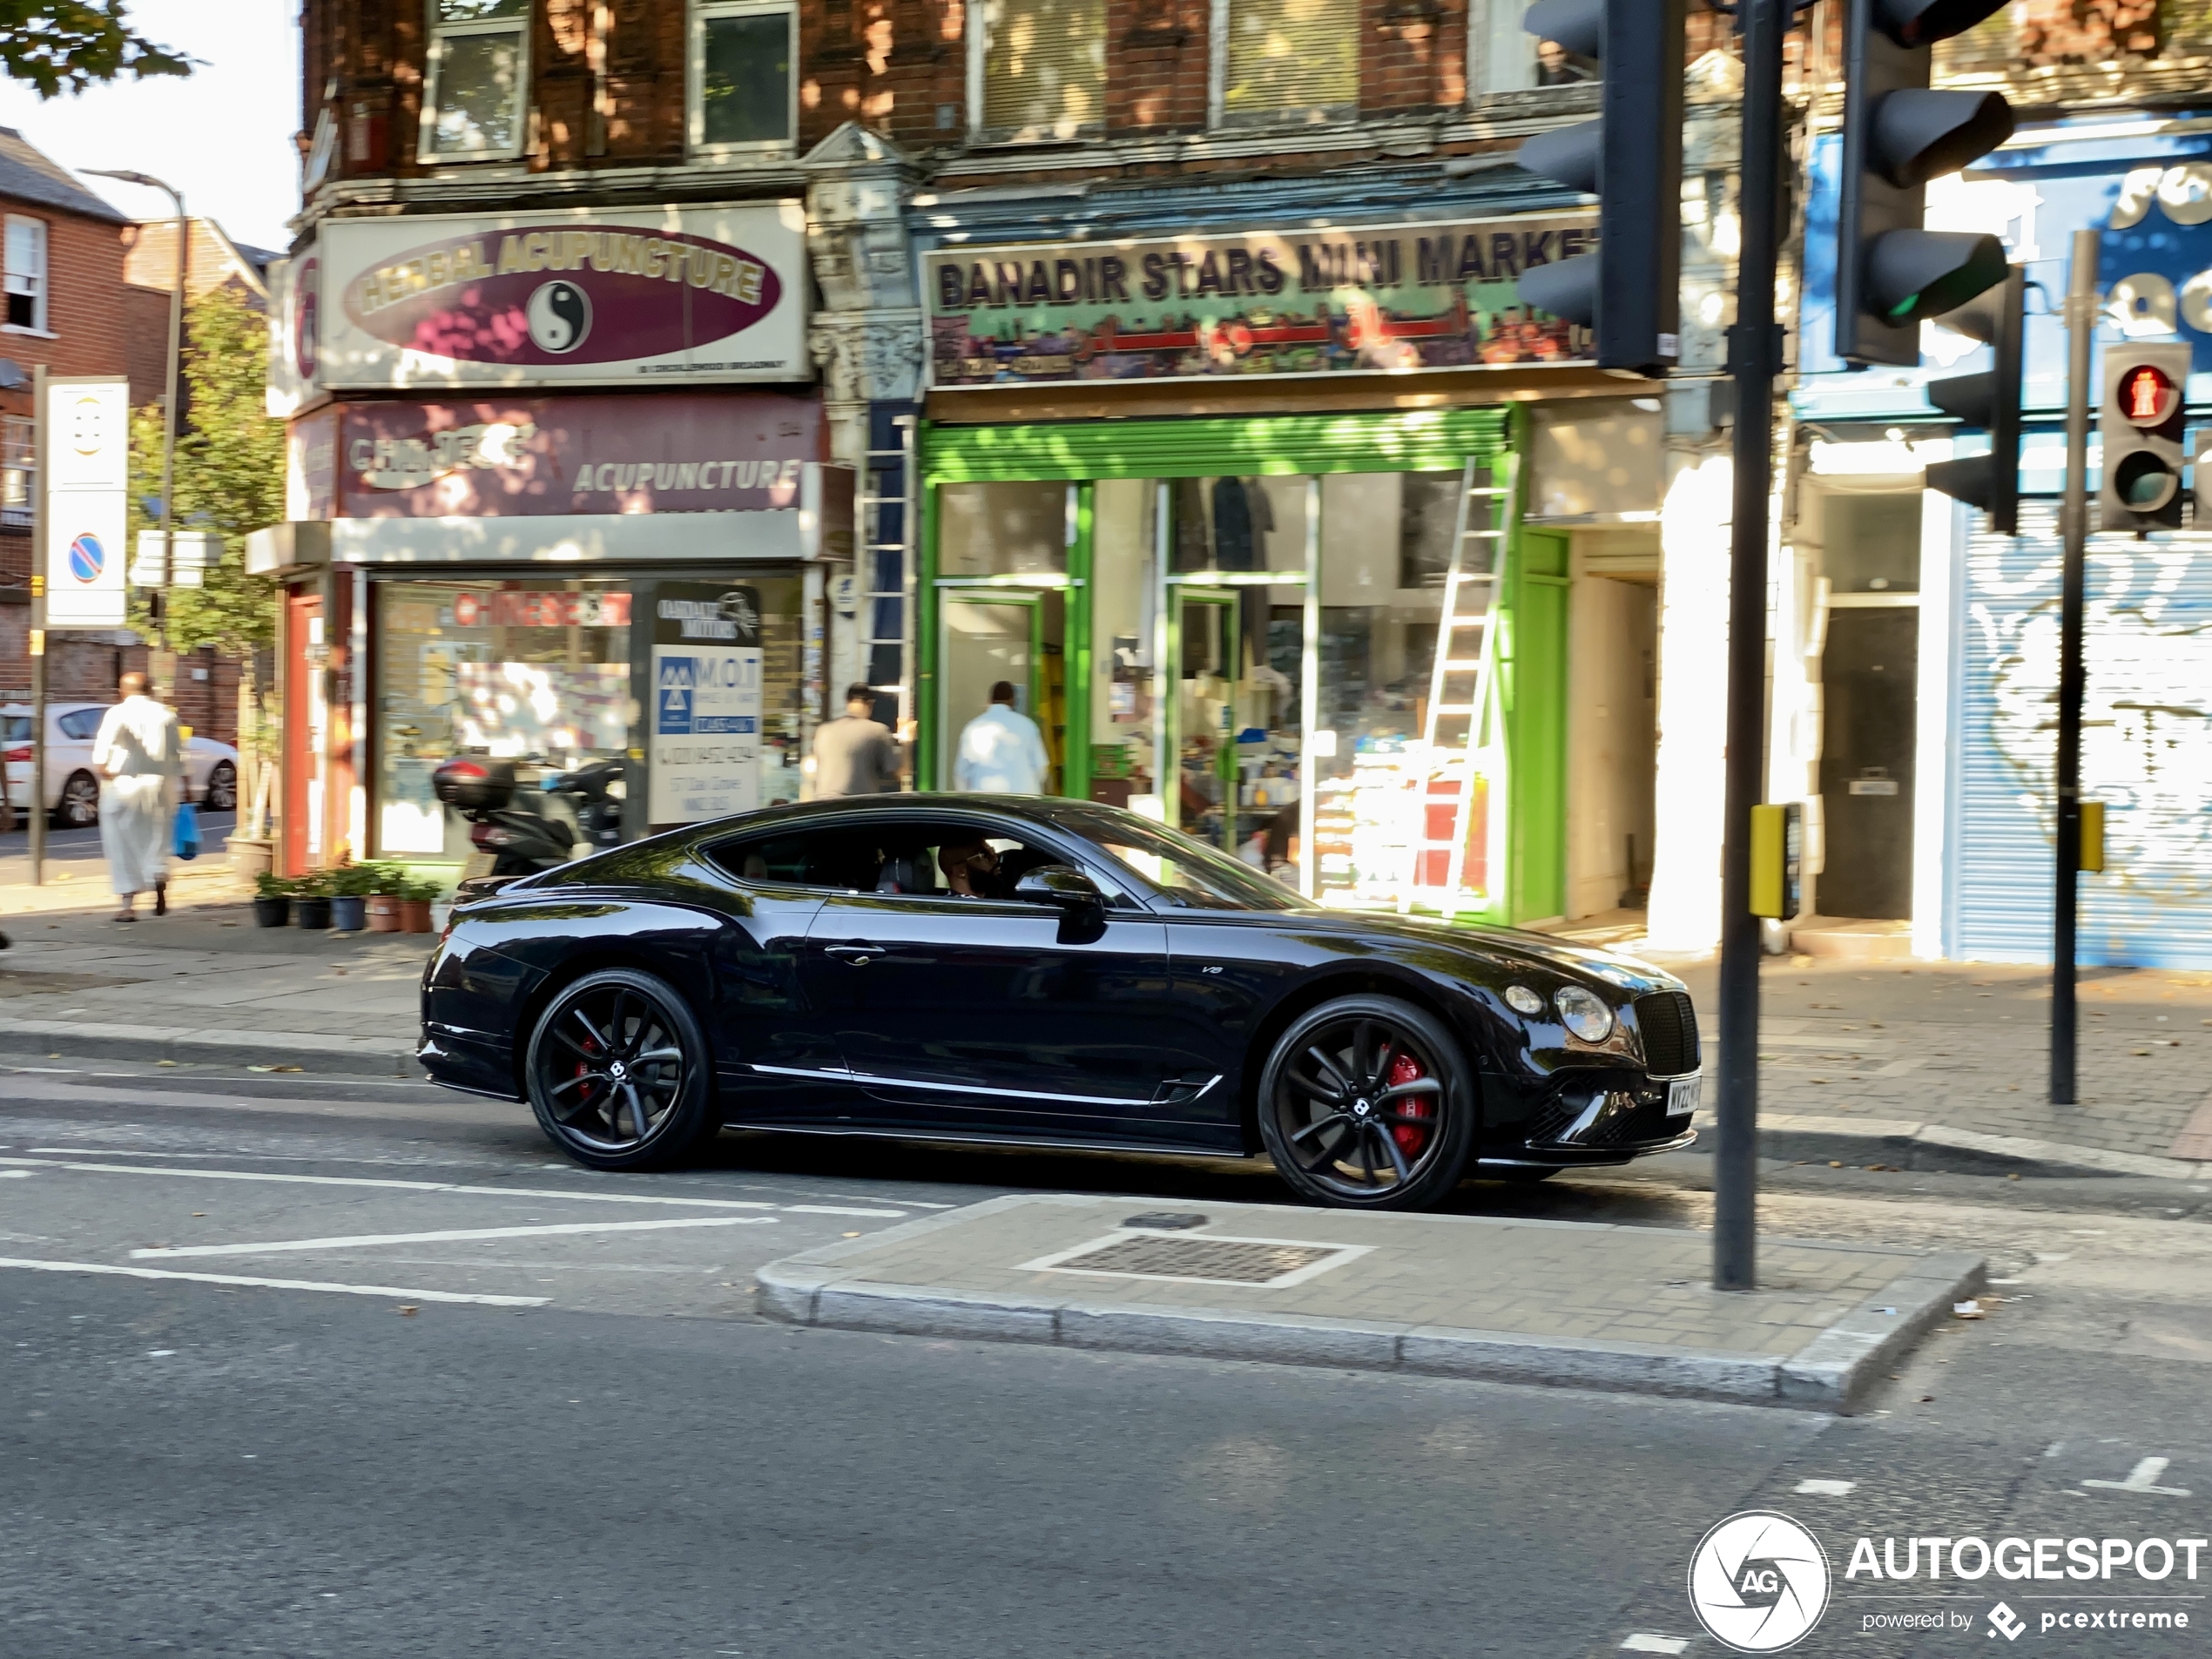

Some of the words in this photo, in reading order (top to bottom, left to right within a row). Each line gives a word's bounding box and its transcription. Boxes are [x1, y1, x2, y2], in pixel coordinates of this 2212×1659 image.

[361, 239, 493, 315] HERBAL
[497, 232, 765, 306] ACUPUNCTURE
[939, 255, 1127, 309] BANADIR
[1142, 246, 1283, 299] STARS
[1299, 238, 1400, 292] MINI
[572, 460, 801, 491] ACUPUNCTURE
